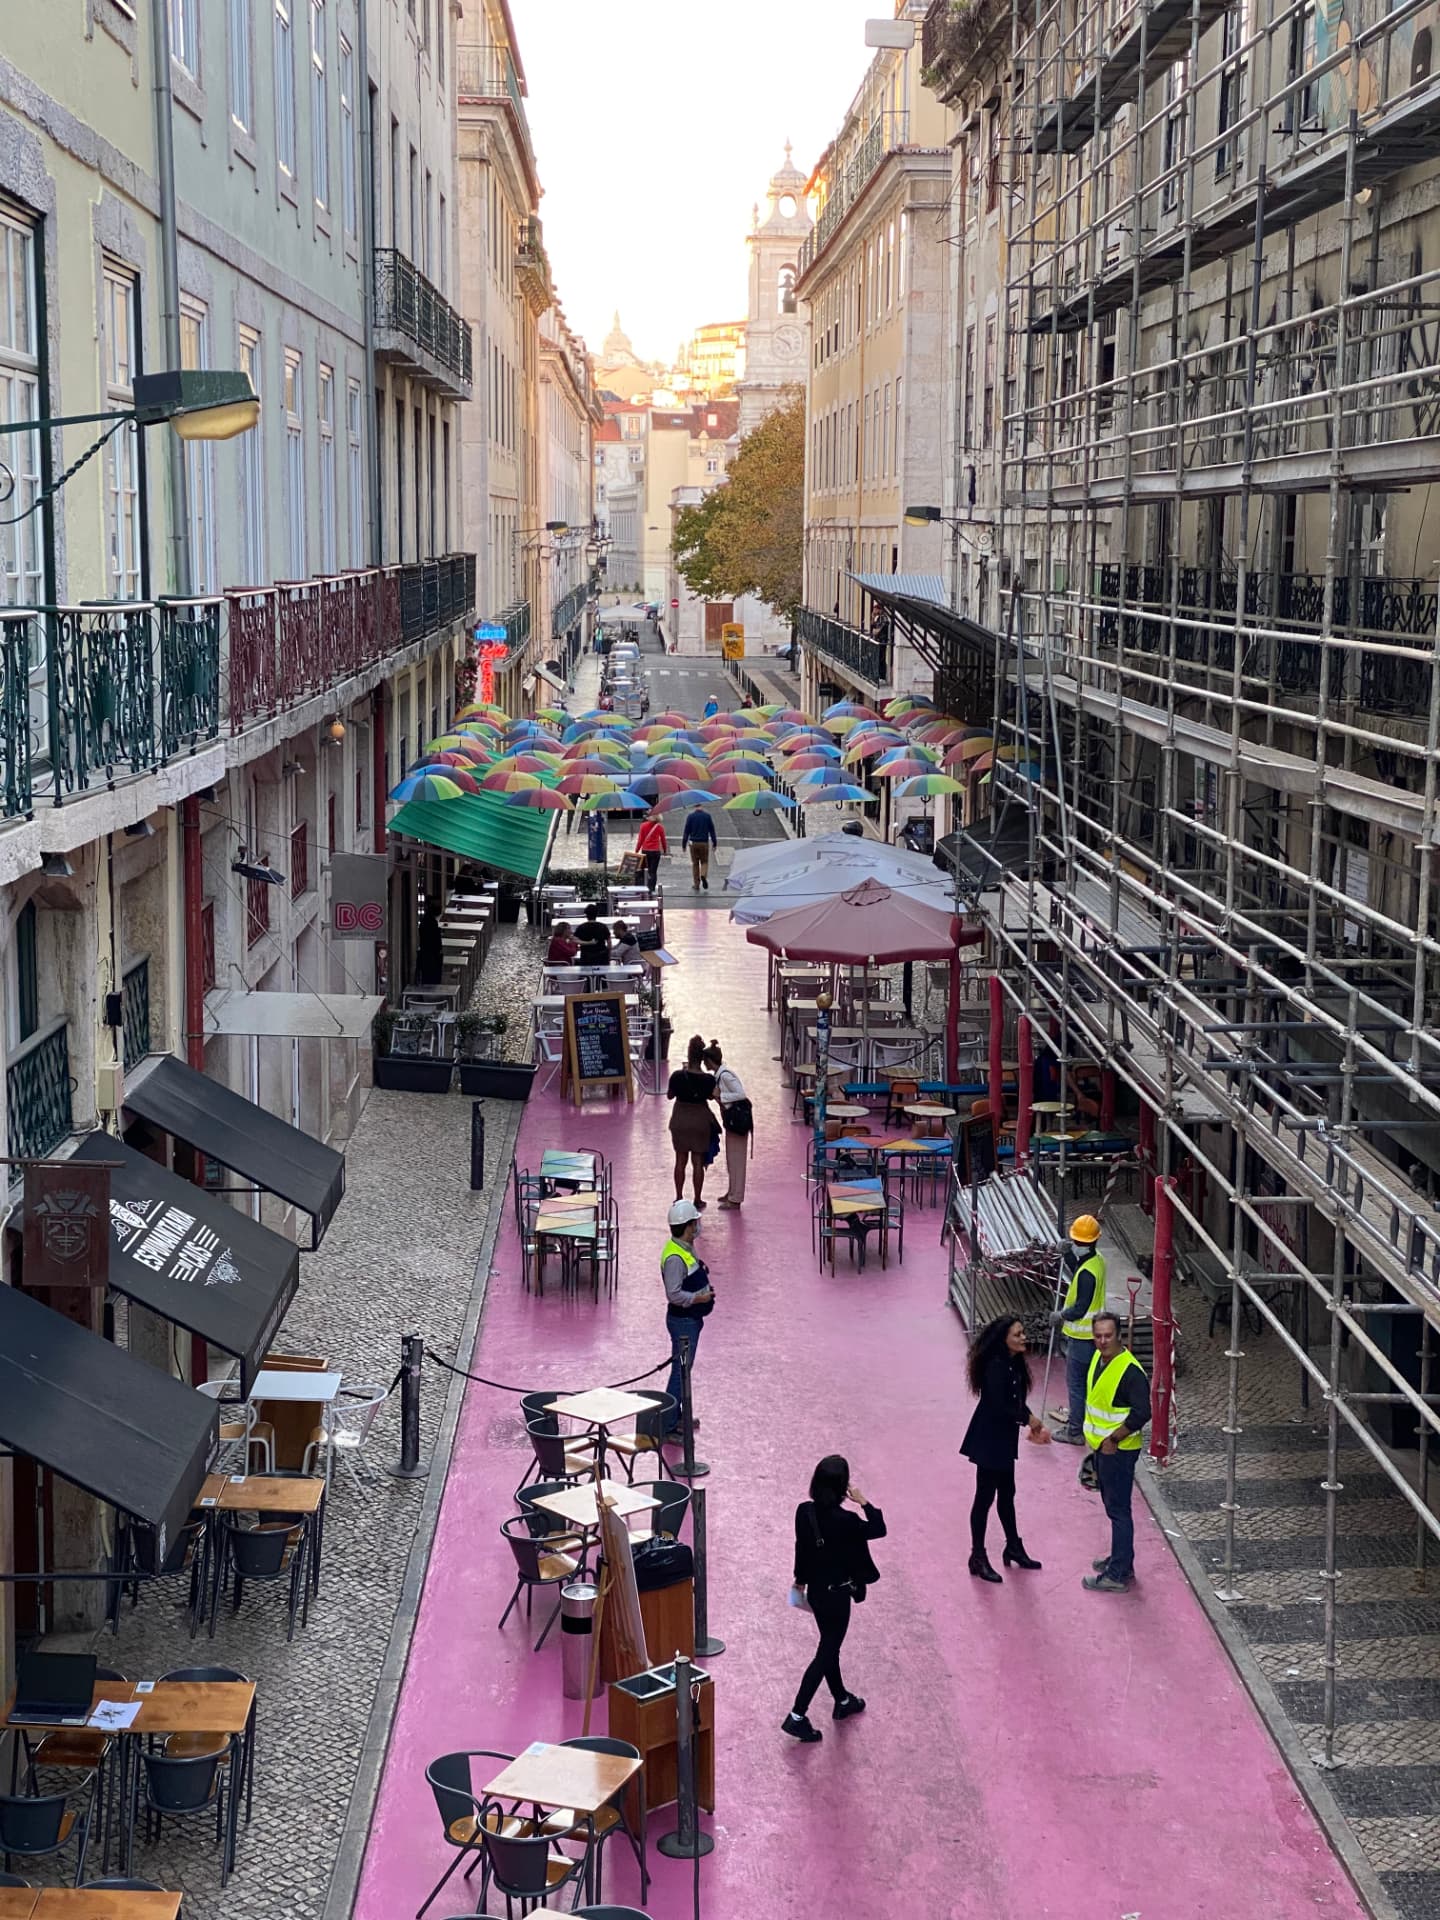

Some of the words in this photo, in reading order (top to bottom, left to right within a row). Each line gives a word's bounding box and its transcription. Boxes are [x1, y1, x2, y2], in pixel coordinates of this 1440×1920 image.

[336, 902, 383, 931] BC
[132, 1206, 197, 1272] ESPUMANTARIA
[178, 1240, 213, 1269] CAIS
